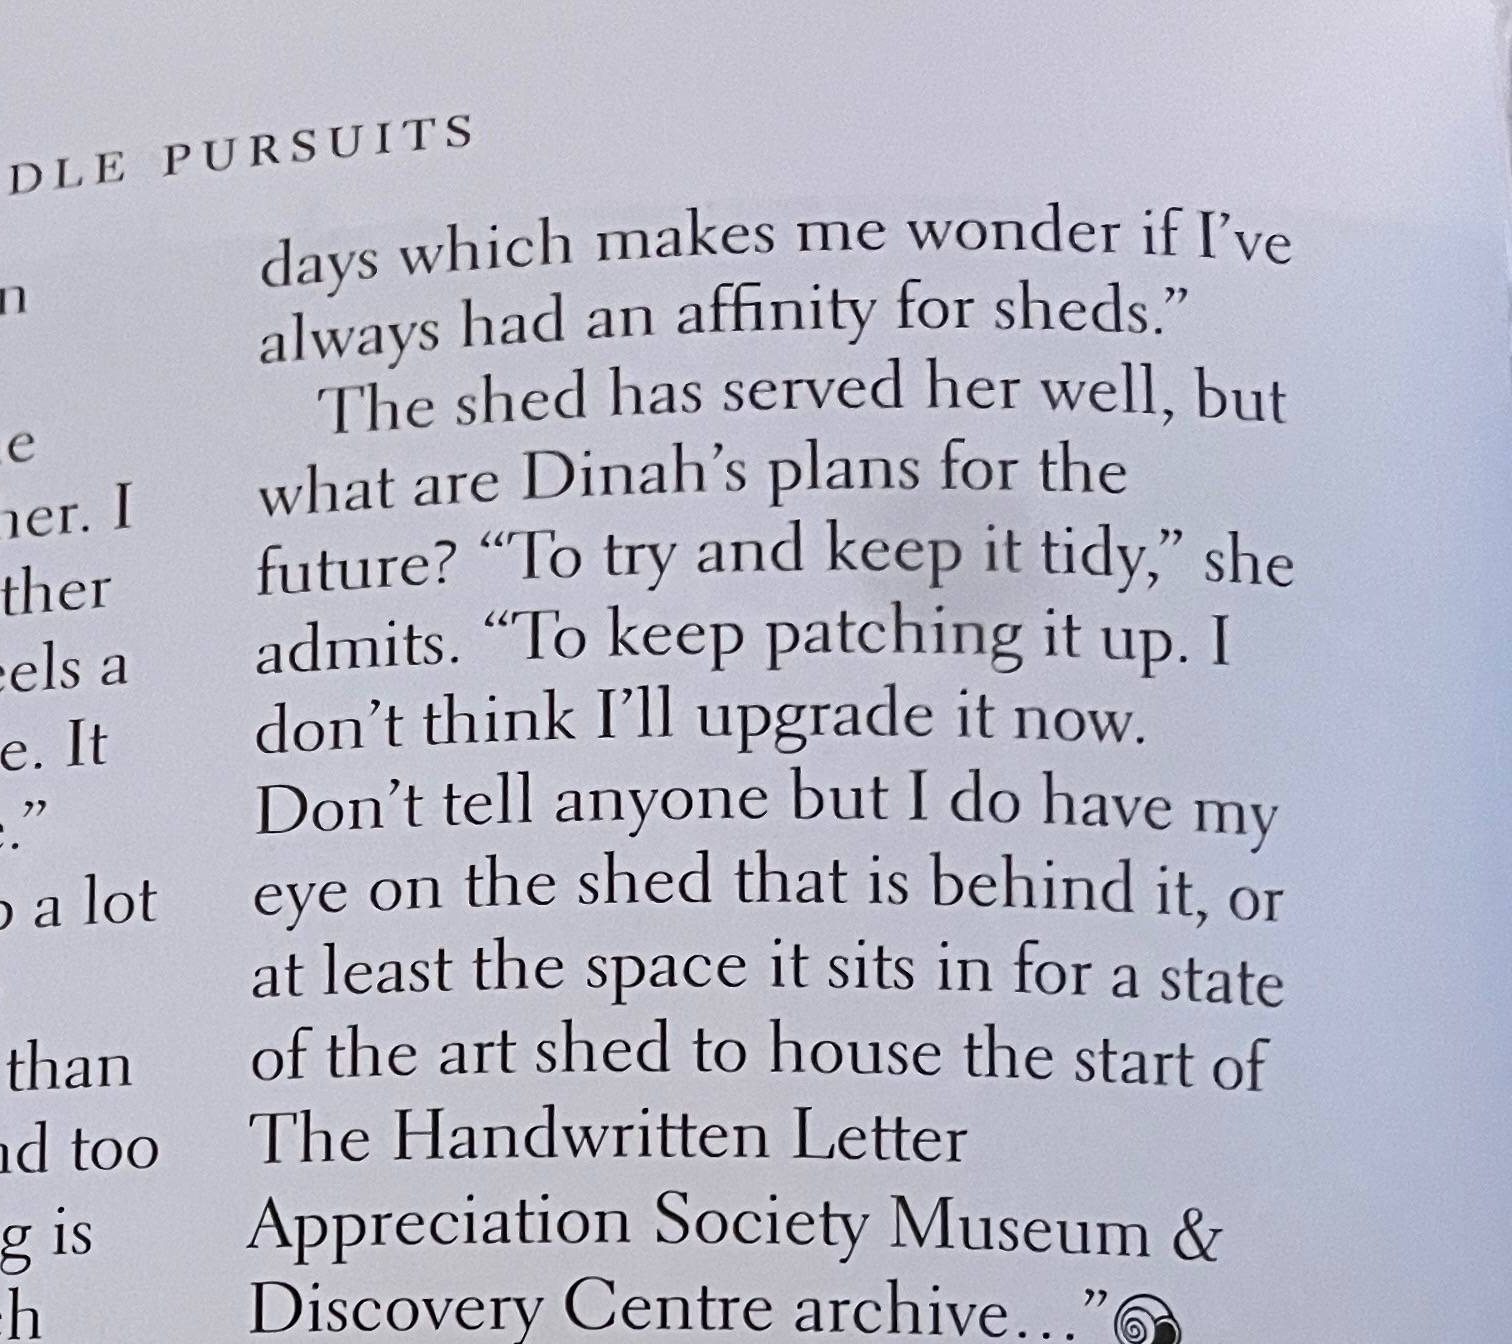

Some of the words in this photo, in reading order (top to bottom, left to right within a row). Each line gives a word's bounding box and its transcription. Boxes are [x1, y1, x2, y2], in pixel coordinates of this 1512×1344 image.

[163, 114, 471, 177] PURSUITS
[317, 381, 434, 435] The
[456, 367, 587, 426] shed
[608, 365, 702, 417] has
[723, 356, 905, 412] served
[925, 356, 1021, 410] her
[1039, 361, 1174, 427] well,
[1193, 365, 1287, 424] but
[34, 896, 62, 929] a
[84, 872, 158, 925] lot
[254, 880, 347, 932] eye
[369, 877, 443, 912] on
[464, 853, 556, 908] the
[578, 849, 713, 905] shed
[734, 848, 849, 904] that
[868, 854, 909, 906] is
[929, 850, 1135, 913] behind
[1156, 864, 1209, 929] it,
[1229, 886, 1285, 922] or
[252, 953, 305, 999] at
[322, 941, 454, 995] least
[471, 935, 564, 991] the
[586, 954, 747, 1006] space
[770, 937, 810, 989] it
[828, 938, 915, 991] sits
[938, 940, 993, 992] in
[1013, 938, 1093, 996] for
[1111, 964, 1140, 999] a
[1160, 956, 1284, 1009] state
[6, 1038, 133, 1092] than
[248, 1108, 370, 1165] The
[393, 1103, 770, 1161] Handwritten
[792, 1106, 969, 1163] Letter
[52, 1206, 92, 1256] is
[245, 1193, 631, 1266] Appreciation
[656, 1189, 871, 1264] Society
[890, 1194, 1151, 1258] Museum
[1173, 1207, 1224, 1263] &
